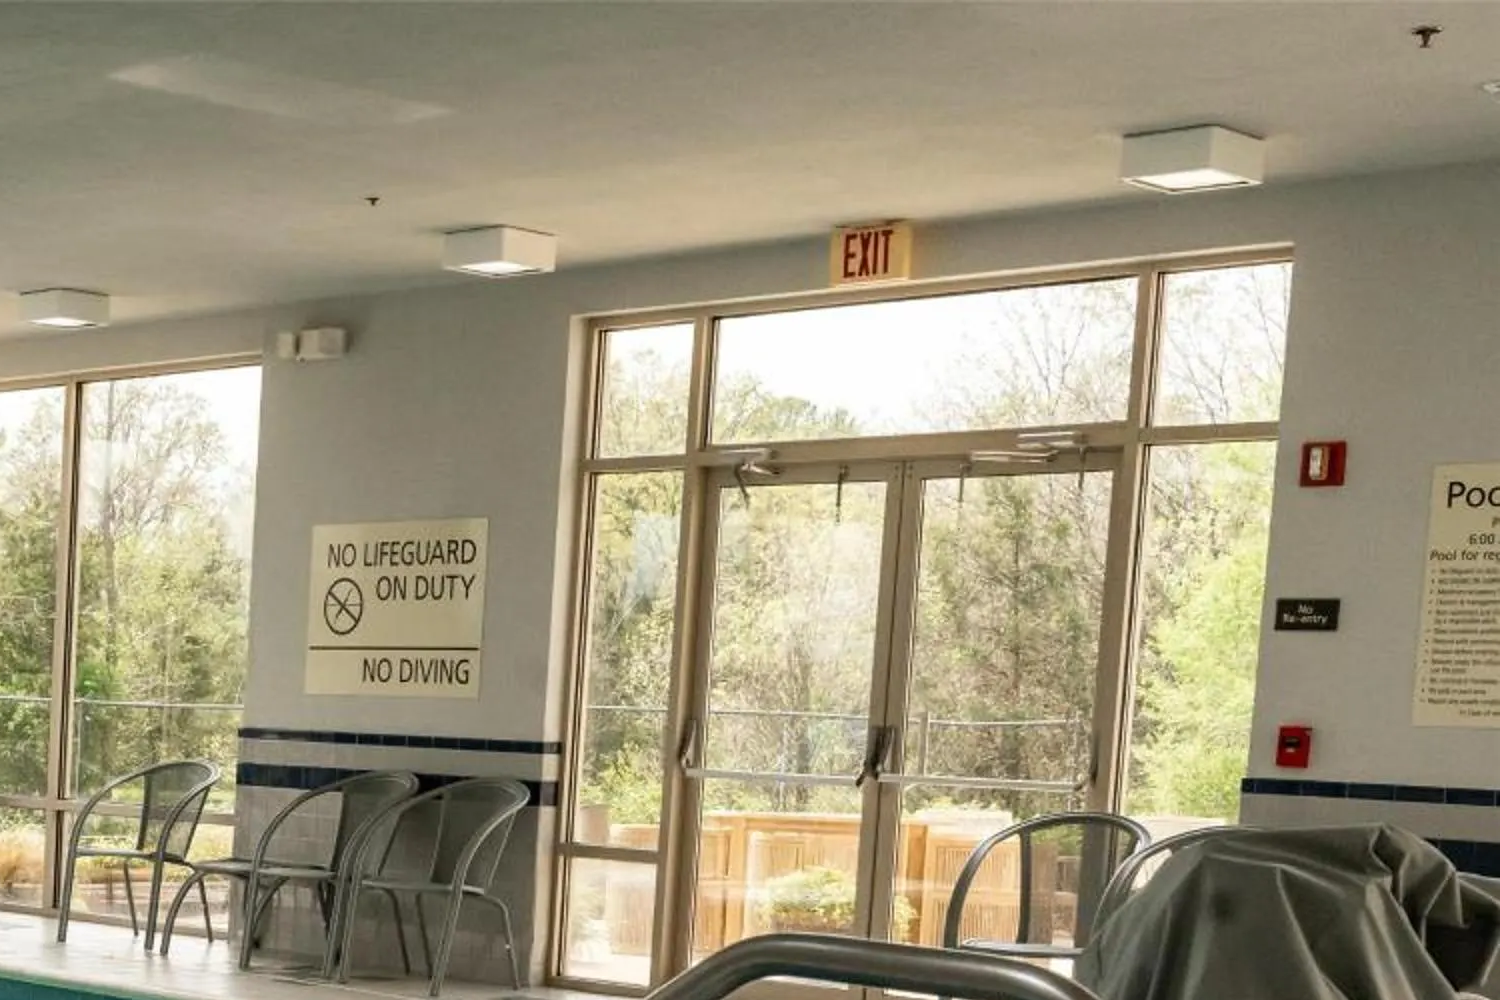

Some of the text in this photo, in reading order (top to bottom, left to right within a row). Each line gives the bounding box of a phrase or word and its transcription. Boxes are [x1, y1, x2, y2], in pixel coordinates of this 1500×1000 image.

[843, 229, 894, 278] EXIT
[327, 539, 477, 568] NO LIFEGUARD
[1430, 550, 1457, 561] Pool
[1461, 549, 1479, 560] for
[375, 574, 476, 600] ON DUTY
[362, 658, 470, 685] NO DIVING
